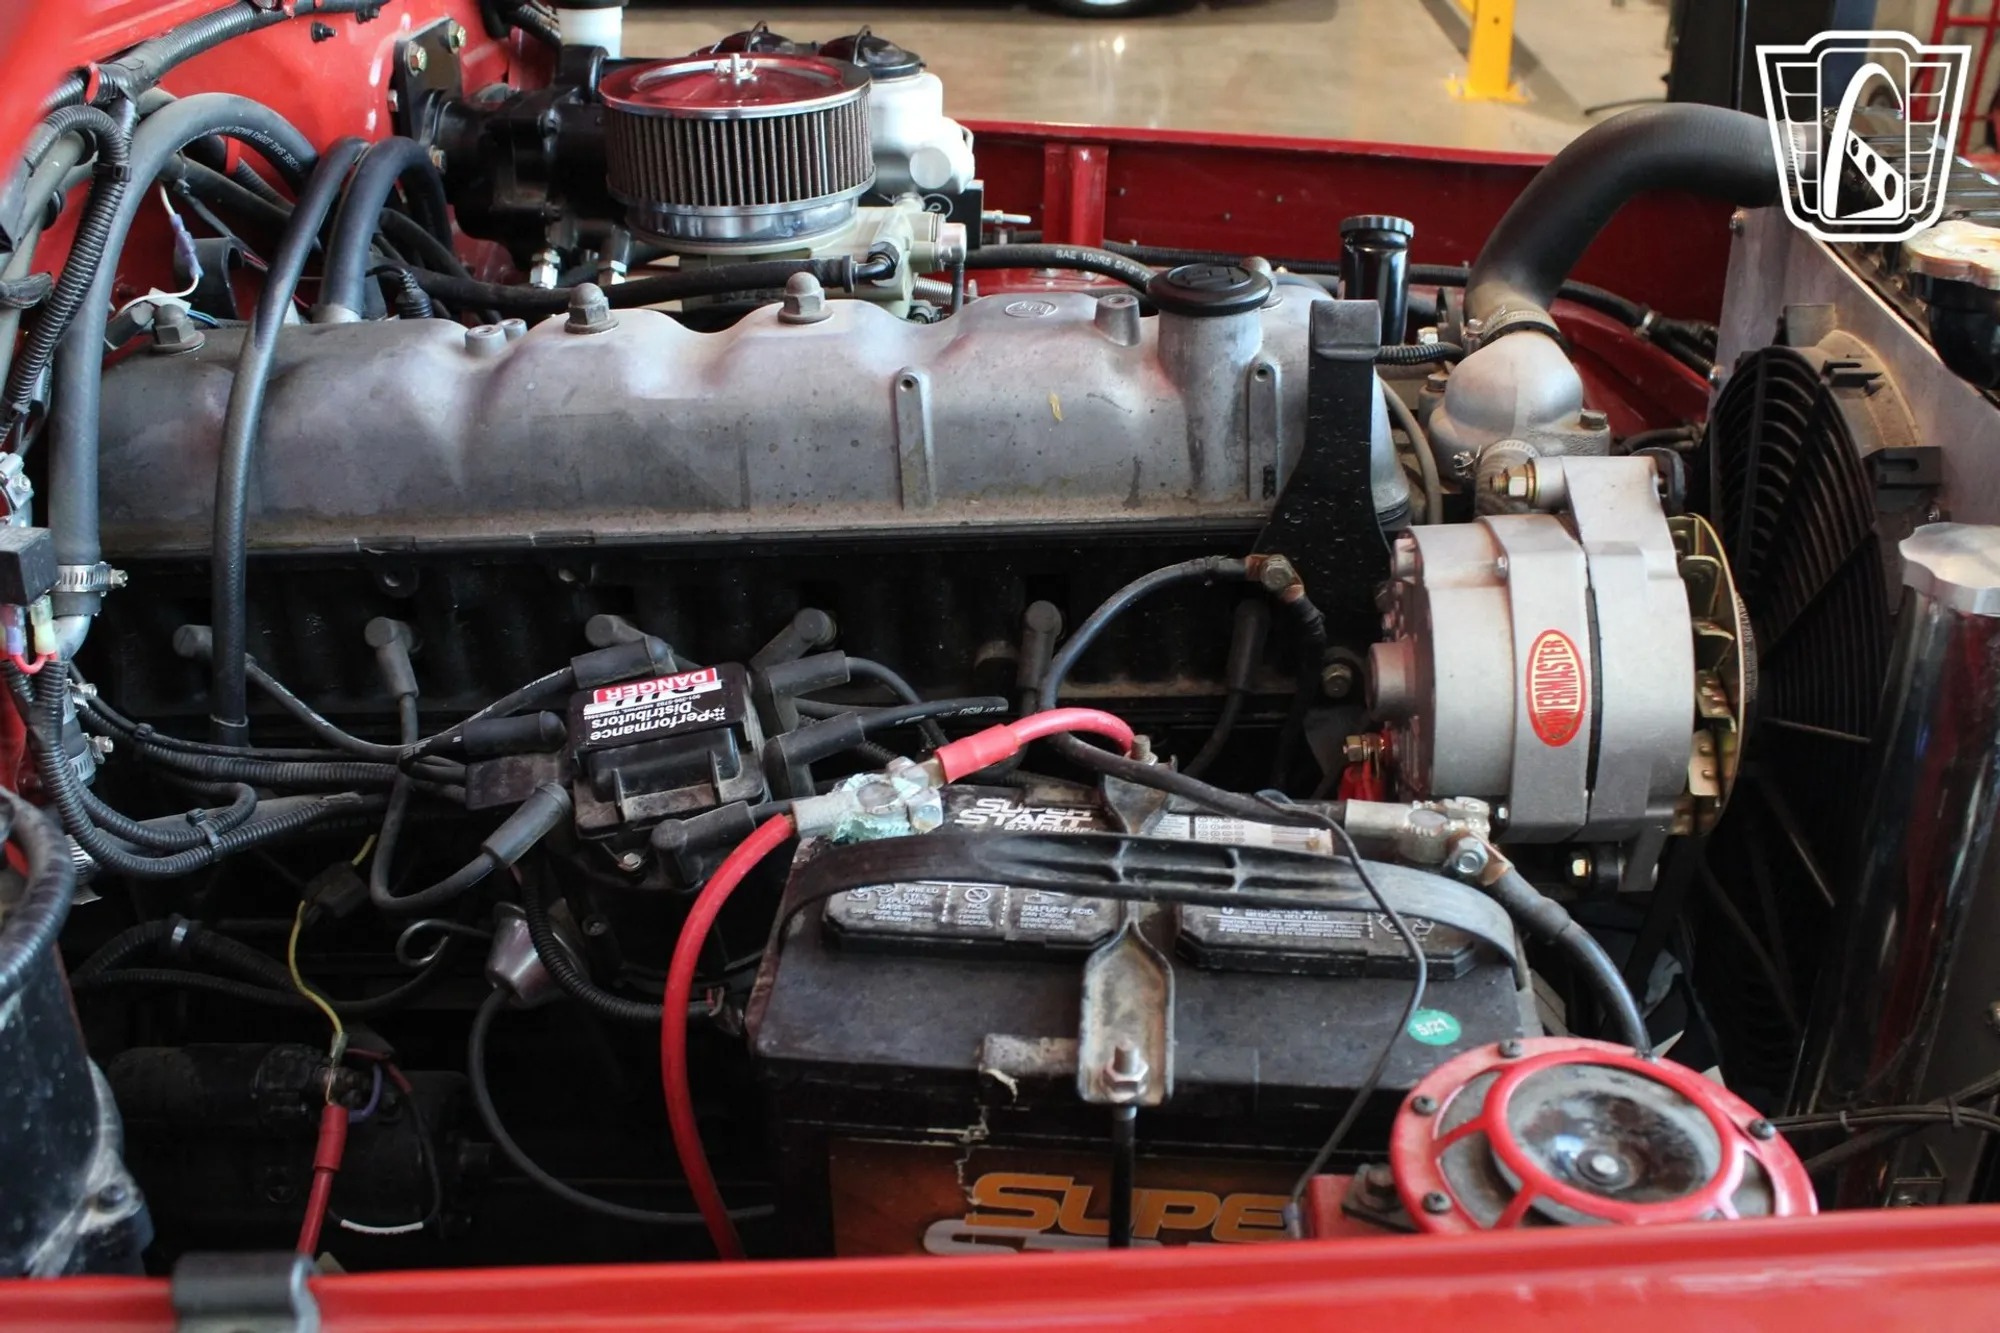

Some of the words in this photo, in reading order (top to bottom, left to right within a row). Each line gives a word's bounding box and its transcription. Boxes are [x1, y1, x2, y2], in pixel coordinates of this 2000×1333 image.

[604, 670, 708, 701] DANGER
[589, 709, 710, 741] Performance
[592, 700, 693, 729] Distributors
[954, 809, 1093, 828] START
[1071, 907, 1095, 916] ACID
[964, 1172, 1293, 1242] SUPE
